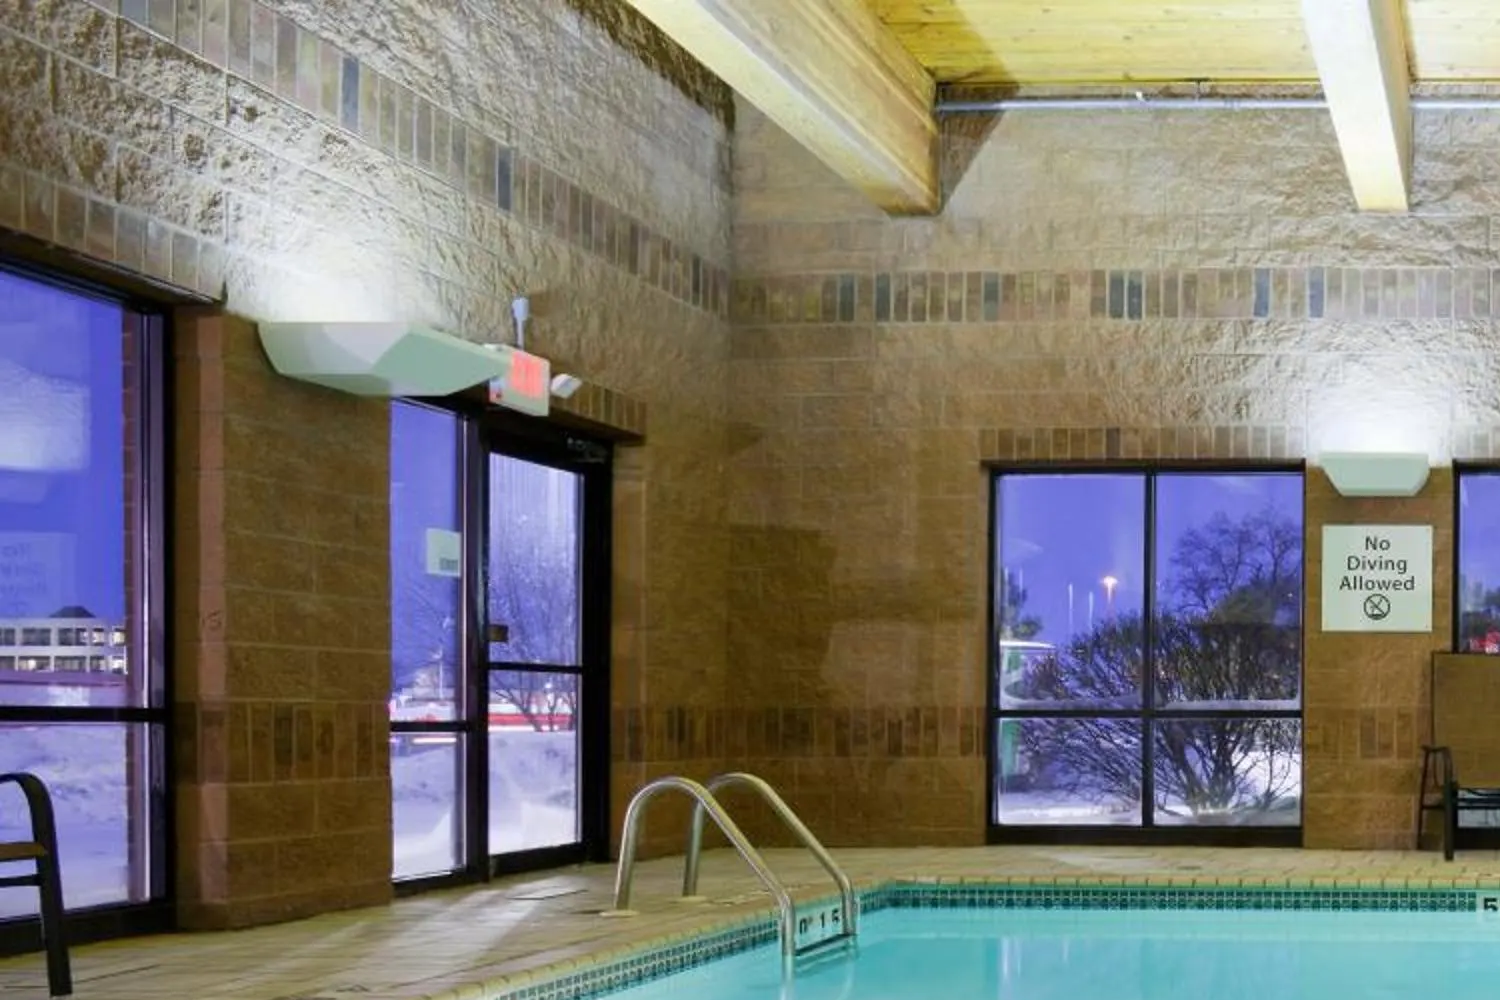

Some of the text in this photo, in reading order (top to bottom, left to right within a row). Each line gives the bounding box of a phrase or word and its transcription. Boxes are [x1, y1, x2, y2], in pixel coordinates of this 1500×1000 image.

[1365, 536, 1390, 550] No
[1347, 555, 1407, 574] Diving
[1339, 576, 1415, 590] Allowed
